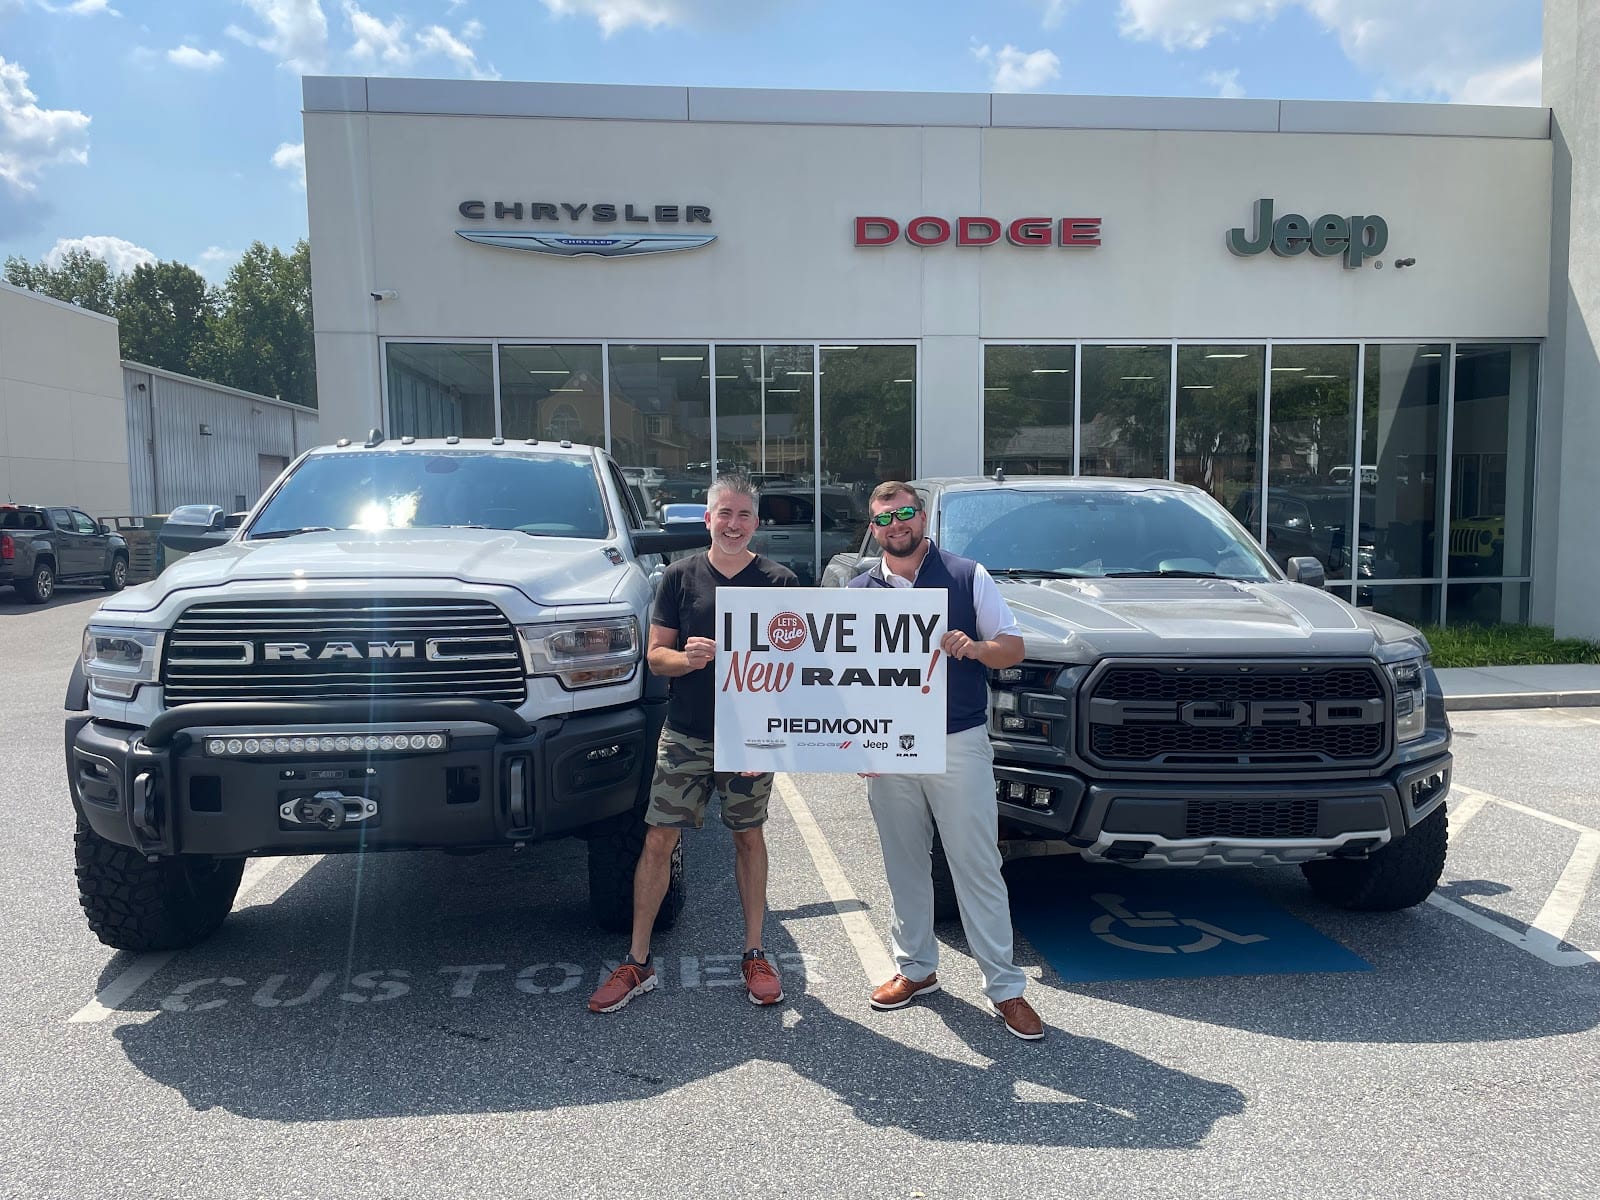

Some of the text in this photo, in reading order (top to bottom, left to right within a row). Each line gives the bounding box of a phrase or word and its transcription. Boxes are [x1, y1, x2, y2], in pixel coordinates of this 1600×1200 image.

[458, 200, 713, 223] CHRYSLER
[854, 216, 1102, 248] DODGE
[1226, 198, 1389, 269] Jeep
[723, 612, 733, 652] I
[874, 613, 941, 653] MY
[777, 617, 798, 627] LET'S
[772, 627, 805, 644] Ride
[264, 641, 415, 660] RAM
[722, 650, 795, 693] New
[1089, 698, 1385, 727] FORD
[767, 717, 893, 735] PIEDMONT
[862, 740, 888, 750] Jeep
